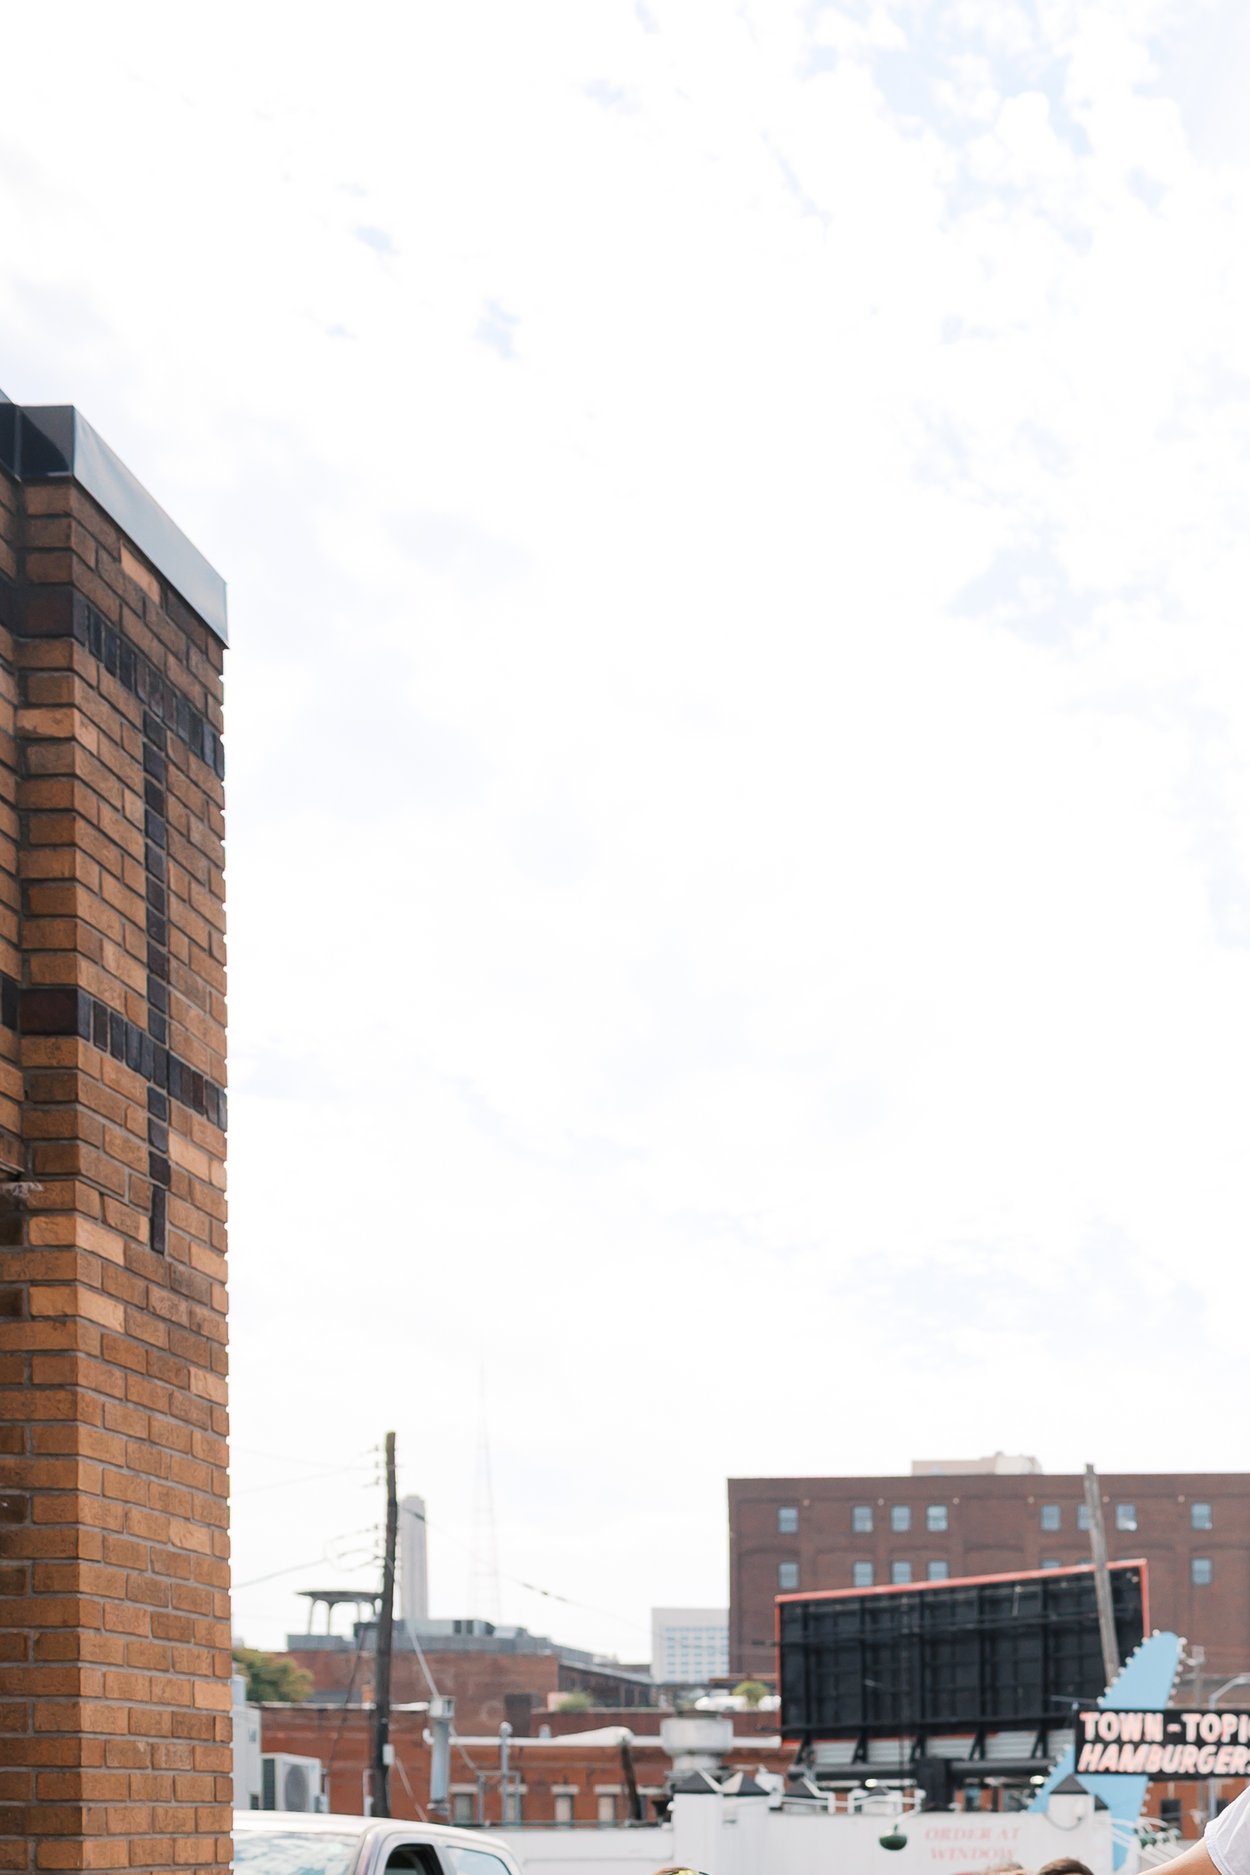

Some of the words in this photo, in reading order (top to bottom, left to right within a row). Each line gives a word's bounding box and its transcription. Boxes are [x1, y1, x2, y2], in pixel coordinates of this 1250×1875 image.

[924, 1827, 992, 1841] ORDER
[998, 1827, 1021, 1841] AT
[930, 1847, 1014, 1860] WINDOW
